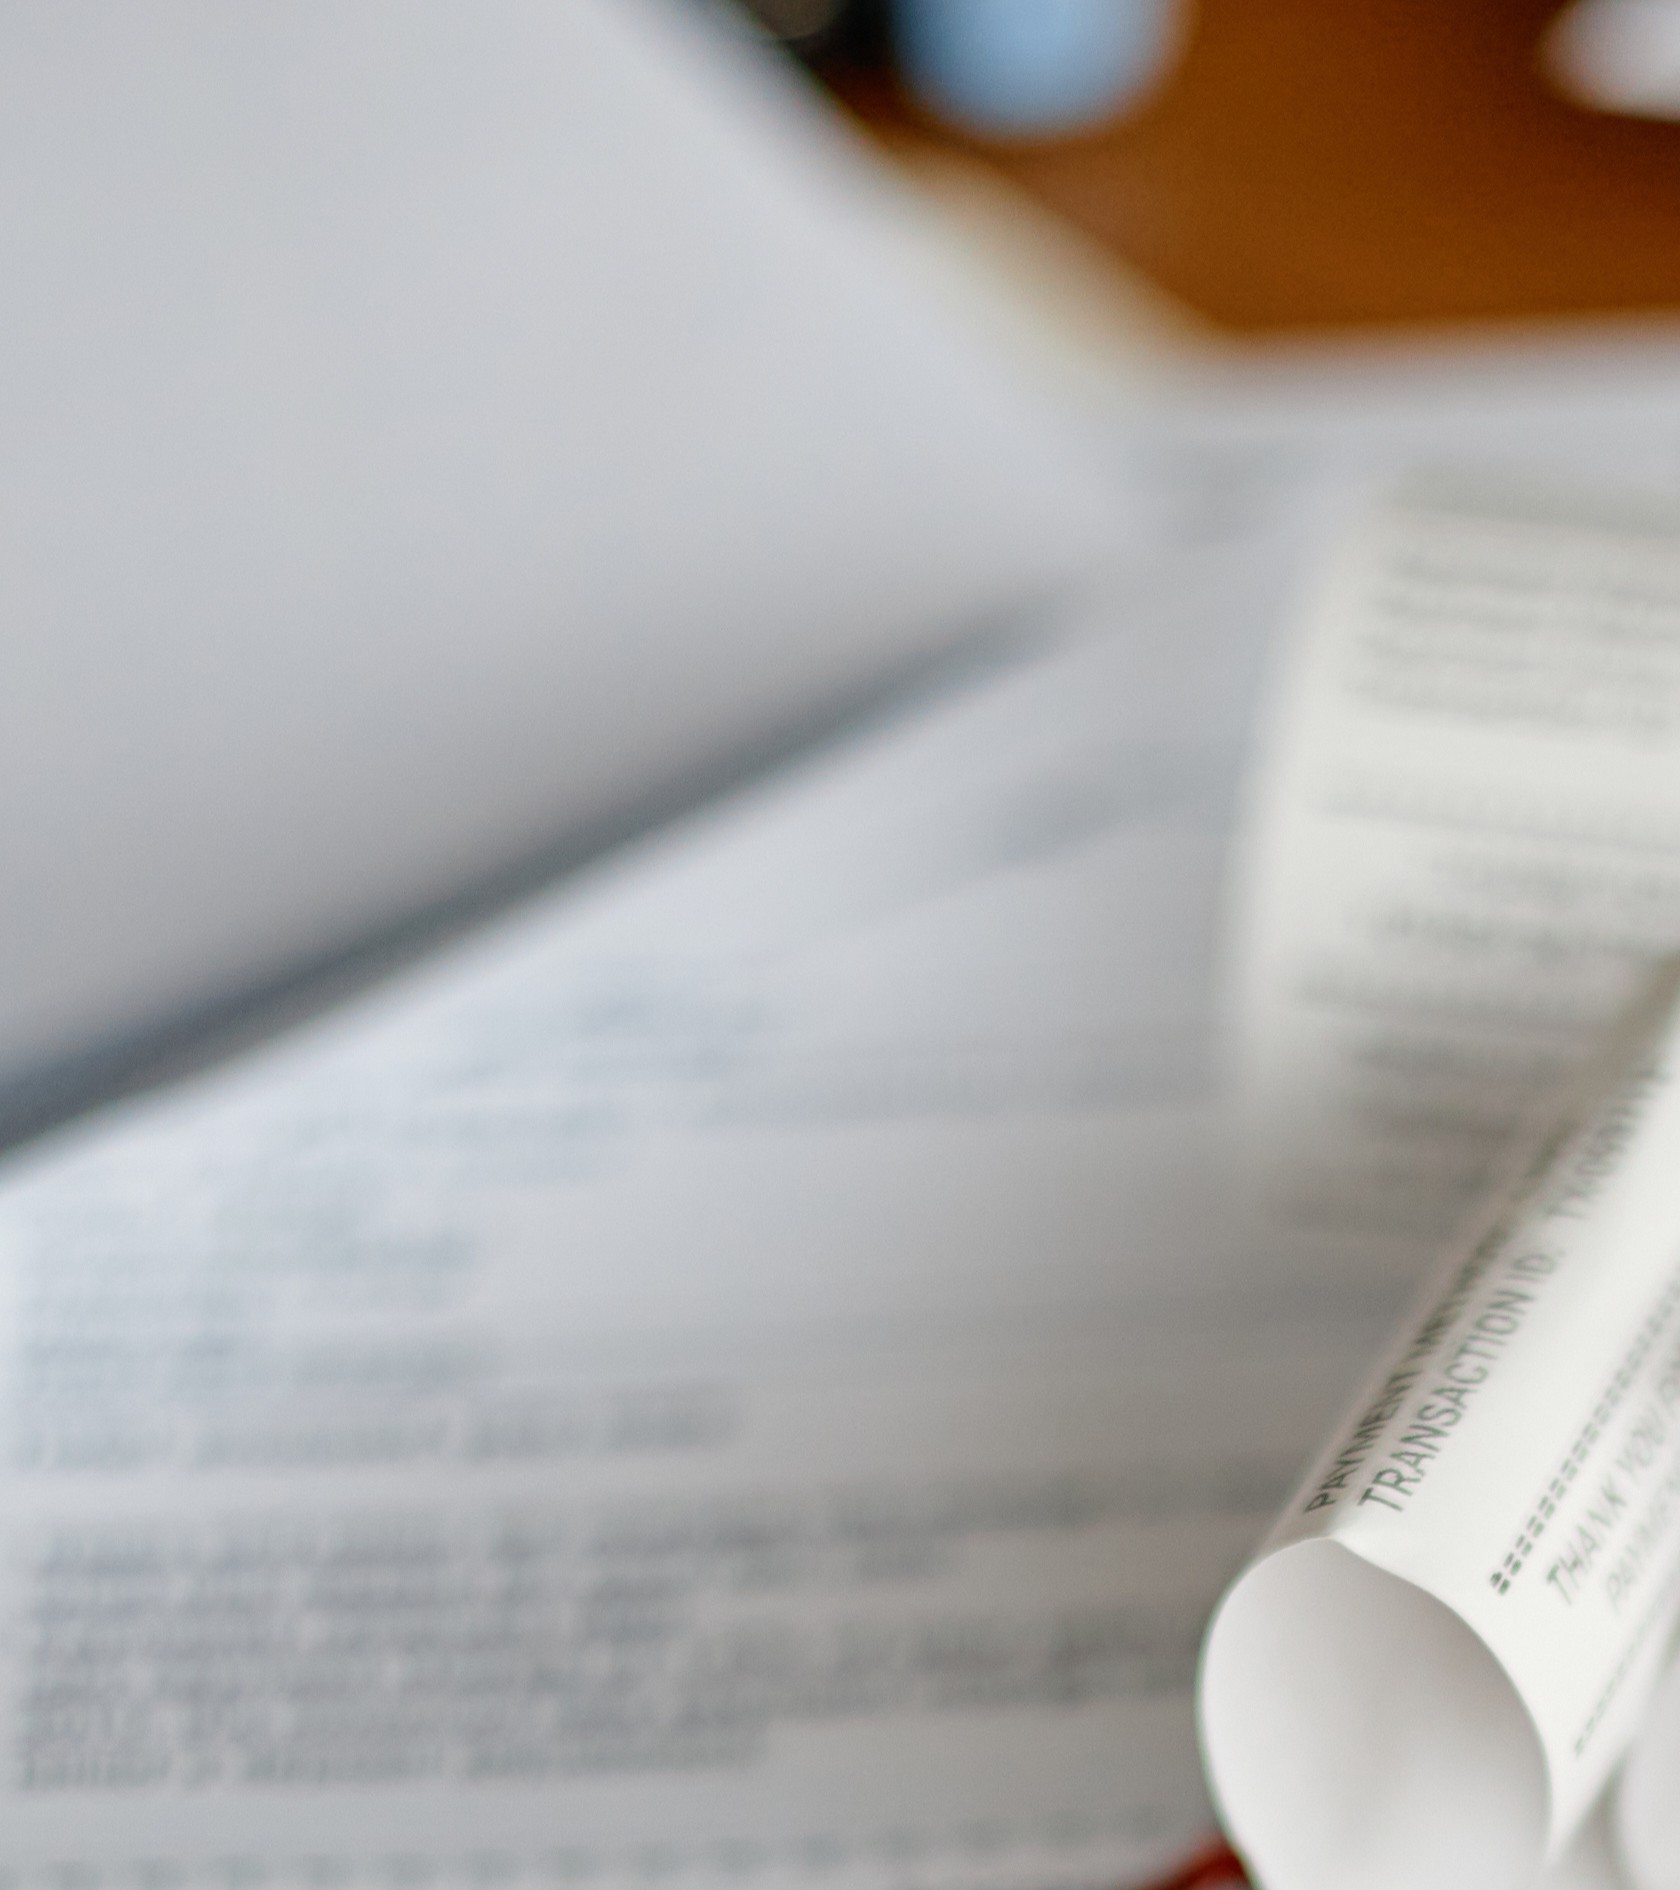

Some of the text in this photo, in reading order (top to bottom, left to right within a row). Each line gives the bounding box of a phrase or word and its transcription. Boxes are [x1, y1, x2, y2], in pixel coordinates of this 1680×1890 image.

[1304, 1354, 1425, 1516] PAYMENT
[1357, 1281, 1527, 1514] TRANSACTION
[1545, 1480, 1632, 1606] THANK
